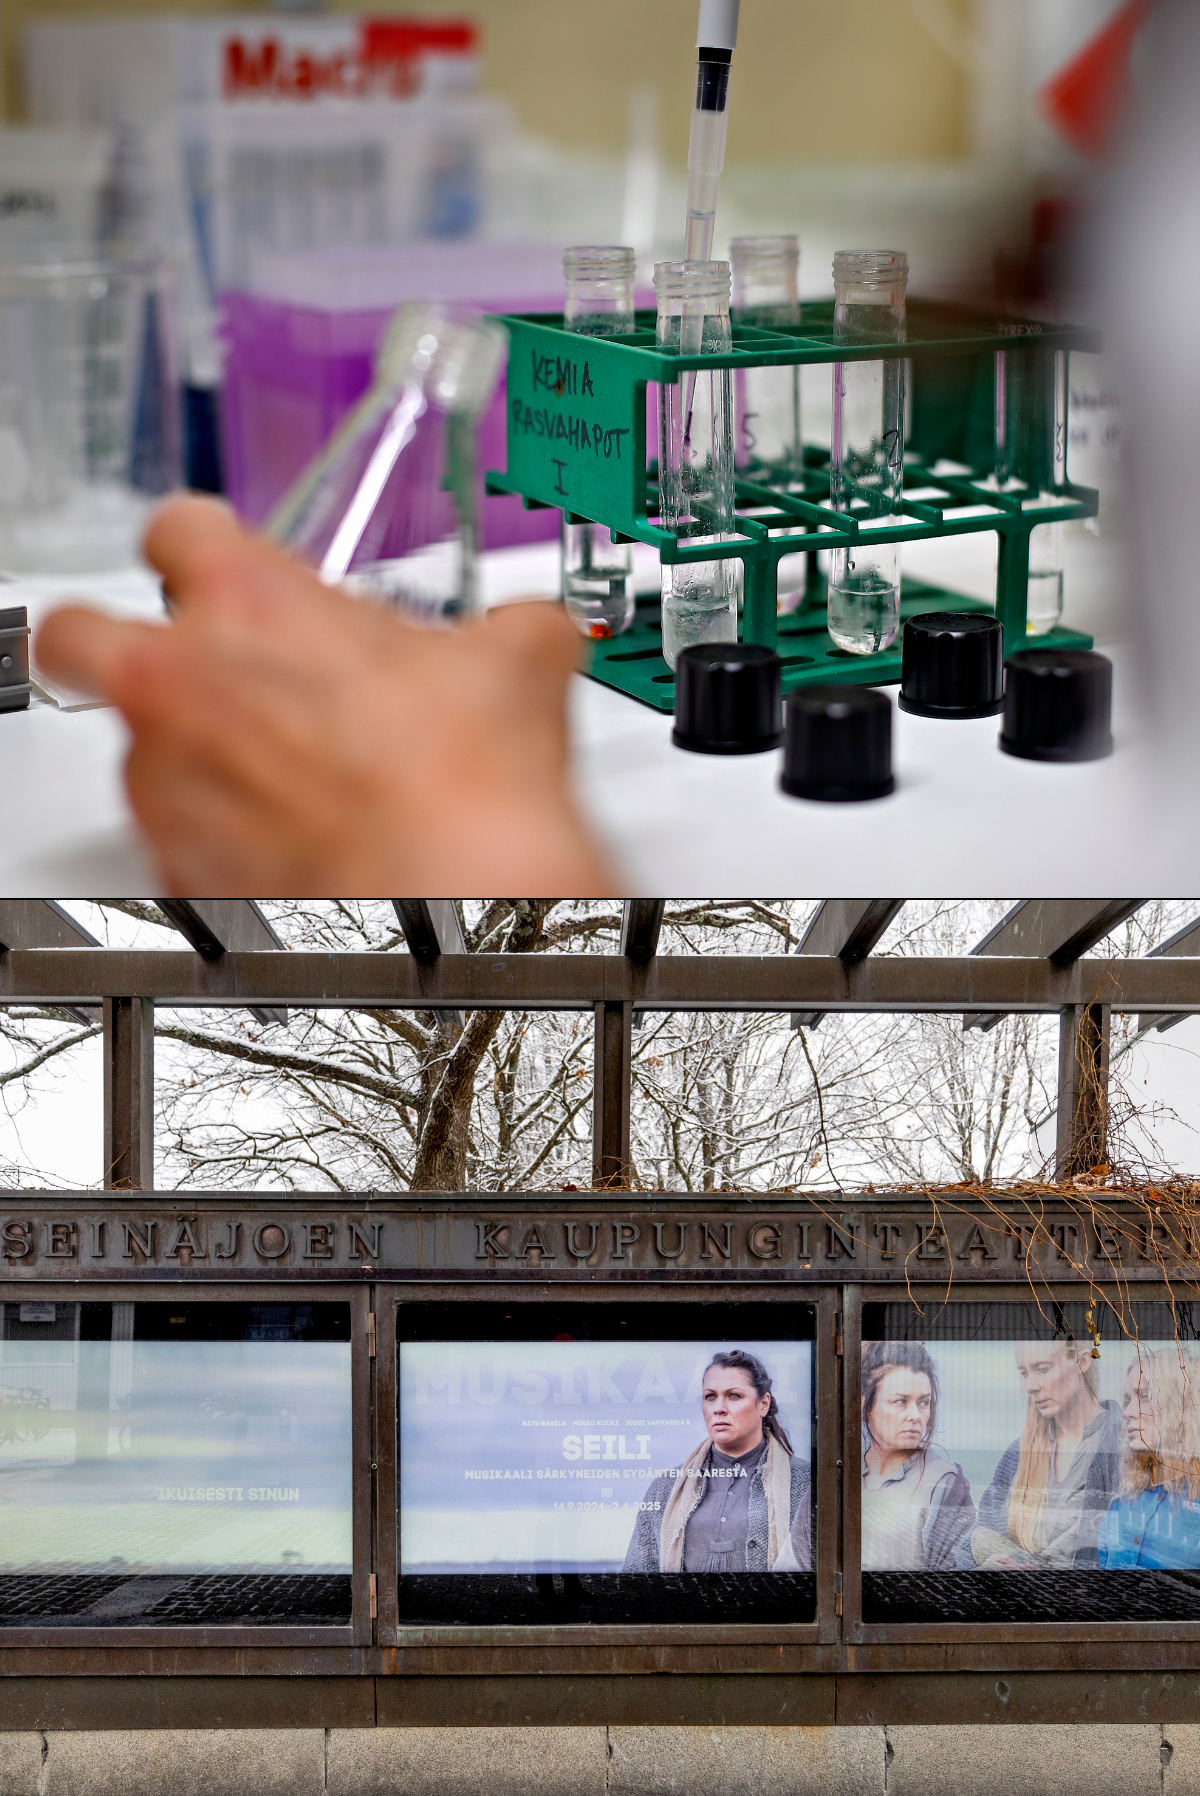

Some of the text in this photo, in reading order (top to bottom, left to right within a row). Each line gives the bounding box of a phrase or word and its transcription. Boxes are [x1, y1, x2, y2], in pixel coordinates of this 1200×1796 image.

[532, 349, 594, 397] KEMIA
[512, 398, 630, 460] RASVAHAPOT
[1, 1217, 384, 1259] SEINÄJOEN
[562, 1434, 651, 1460] SEILI
[464, 1467, 748, 1480] MUSIKAALI SÄRKYNEIDEN SYDÄNTEN SAARESTA
[158, 1487, 300, 1501] IKUISESTI SINUN
